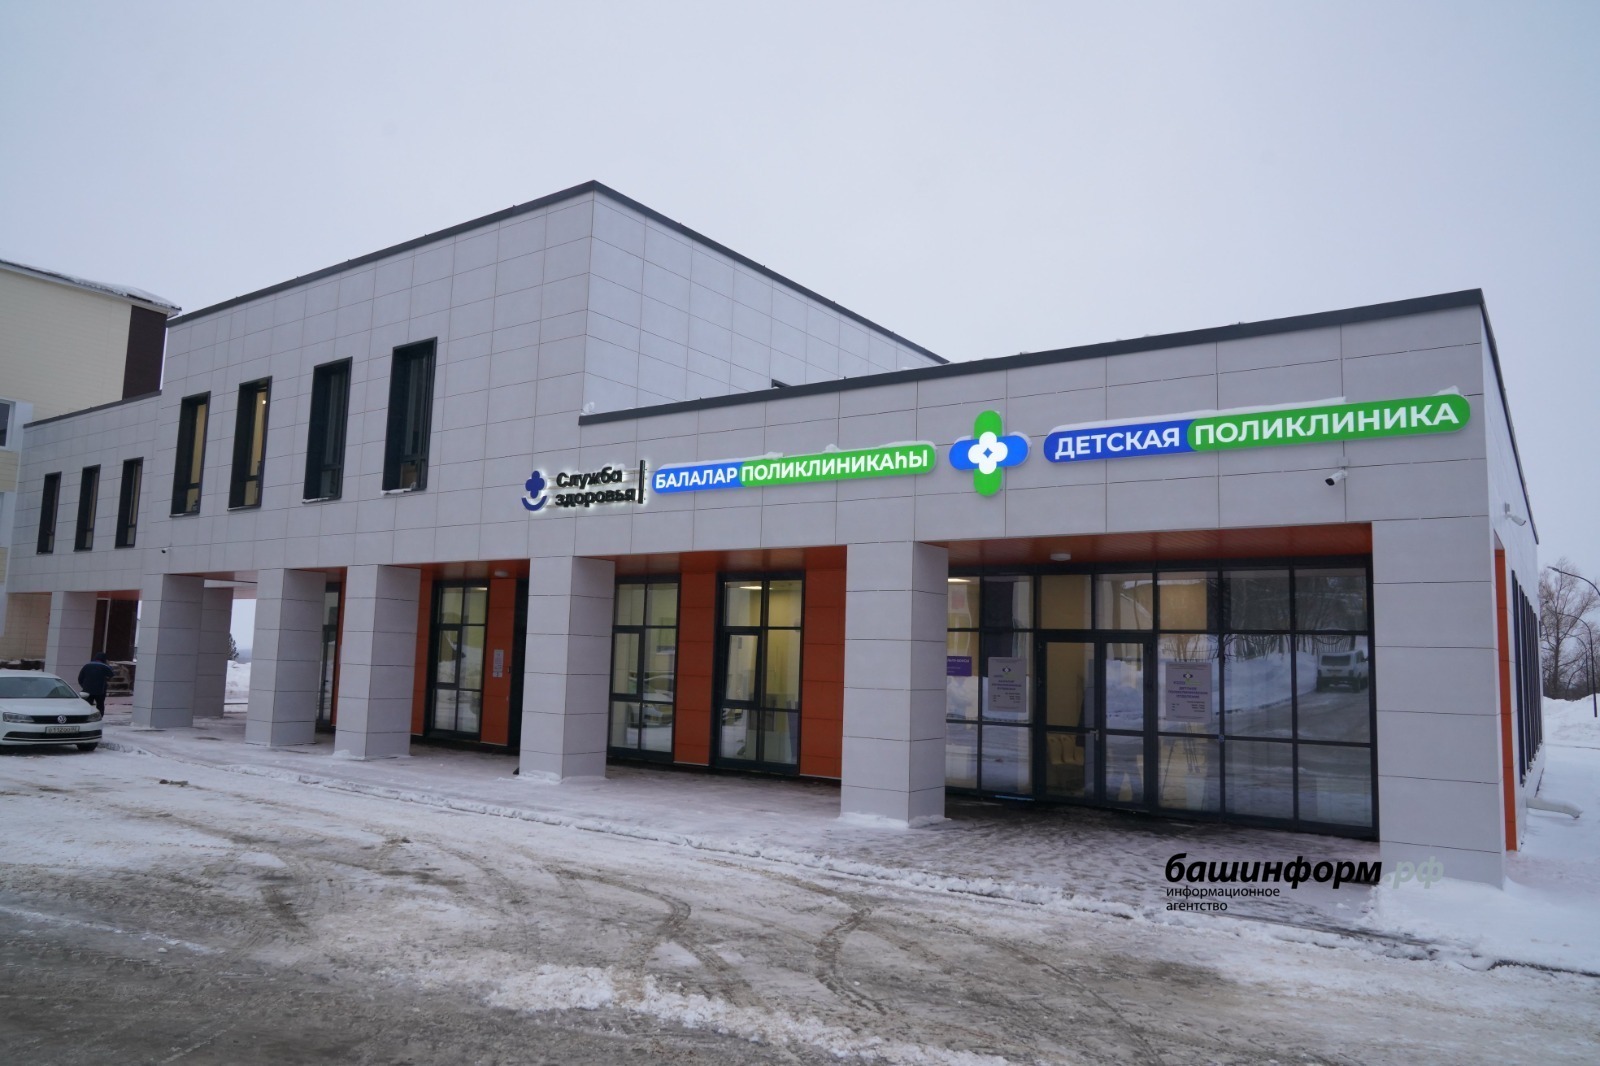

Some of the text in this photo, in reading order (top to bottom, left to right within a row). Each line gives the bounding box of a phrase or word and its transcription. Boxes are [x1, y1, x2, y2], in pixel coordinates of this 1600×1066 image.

[1055, 402, 1459, 459] ДЕТСКАЯ ПОЛИКЛИНИКА
[556, 467, 623, 489] Служба
[655, 469, 738, 490] БАЛАЛАР
[555, 488, 637, 508] здоровья
